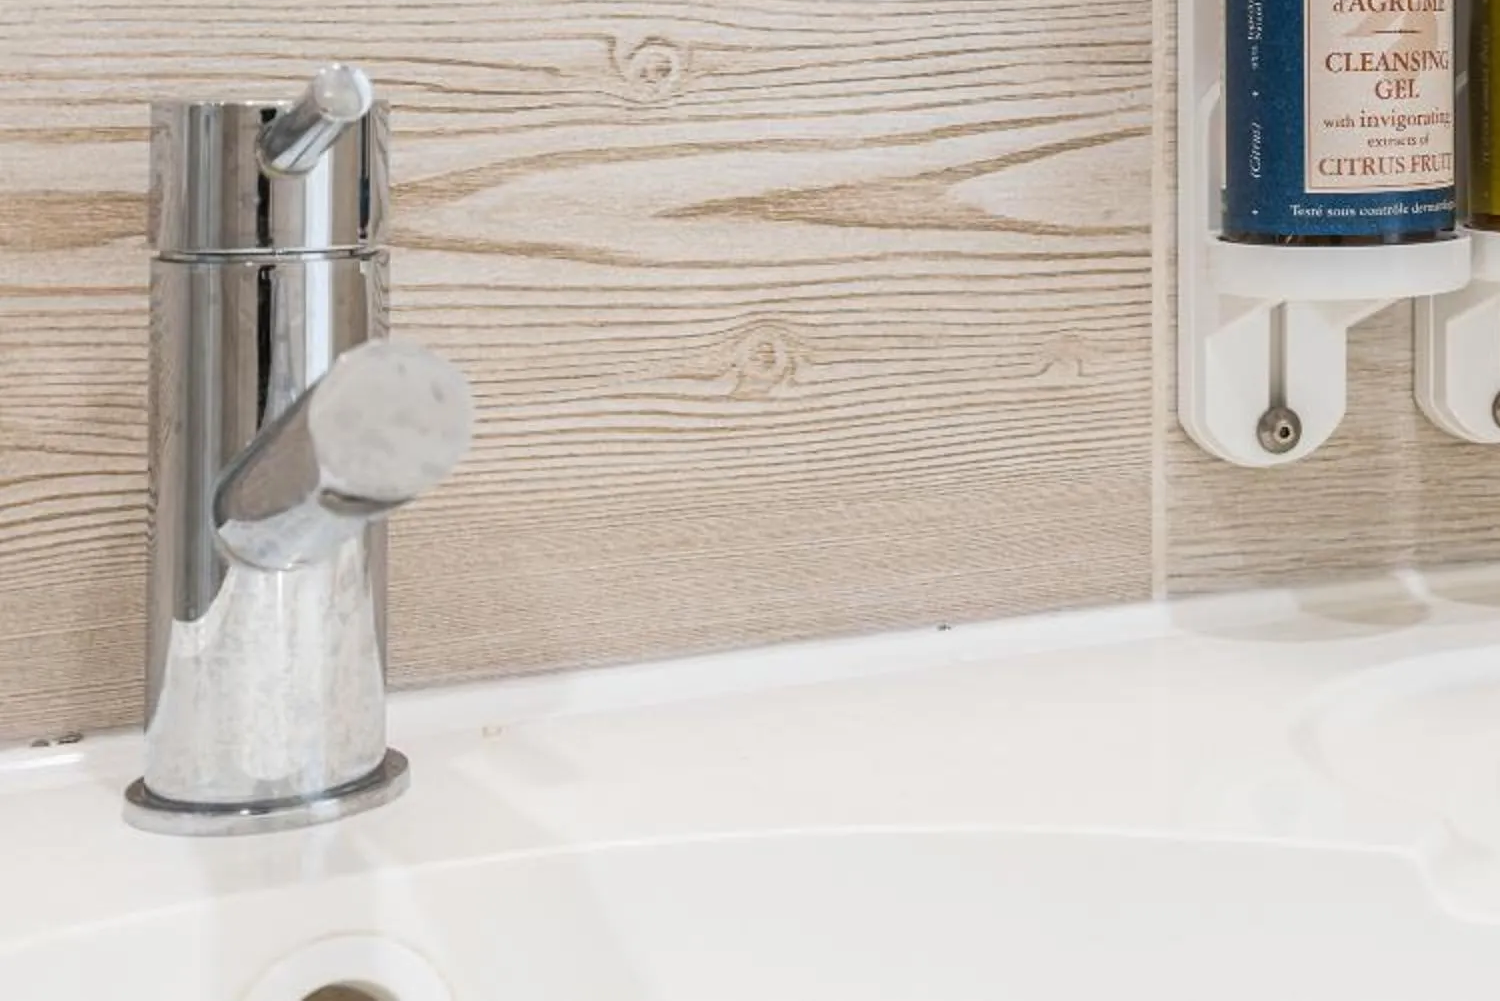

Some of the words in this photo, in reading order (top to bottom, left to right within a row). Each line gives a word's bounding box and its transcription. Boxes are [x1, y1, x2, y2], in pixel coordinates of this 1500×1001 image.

[1325, 50, 1450, 73] CLEANSING
[1375, 80, 1420, 100] GEL
[1323, 113, 1355, 128] with
[1319, 156, 1405, 177] CITRUS
[1327, 206, 1357, 216] sous
